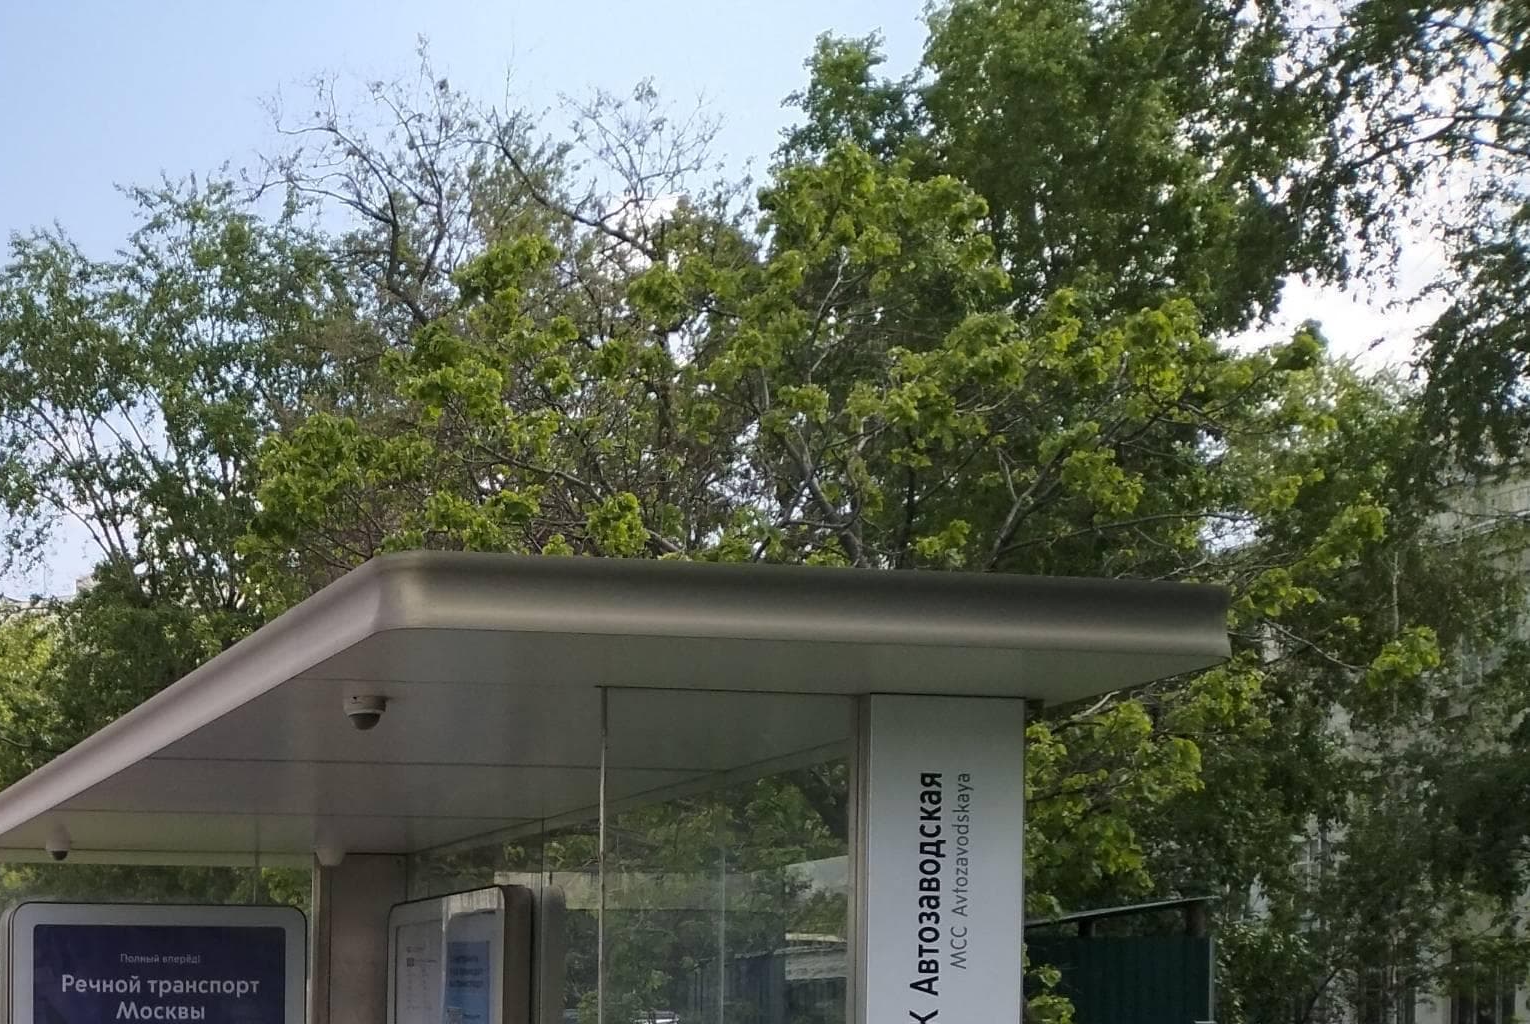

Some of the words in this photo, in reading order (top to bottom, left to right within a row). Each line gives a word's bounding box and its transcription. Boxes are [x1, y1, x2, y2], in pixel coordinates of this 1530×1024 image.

[951, 772, 974, 917] Avtozavodskaya
[909, 772, 946, 996] Автозаводская
[120, 953, 160, 964] Полный
[162, 954, 201, 964] вперёд!
[950, 926, 968, 970] MCC
[61, 974, 141, 993] Речной
[147, 979, 260, 997] транспорт
[116, 1001, 205, 1020] Москвы
